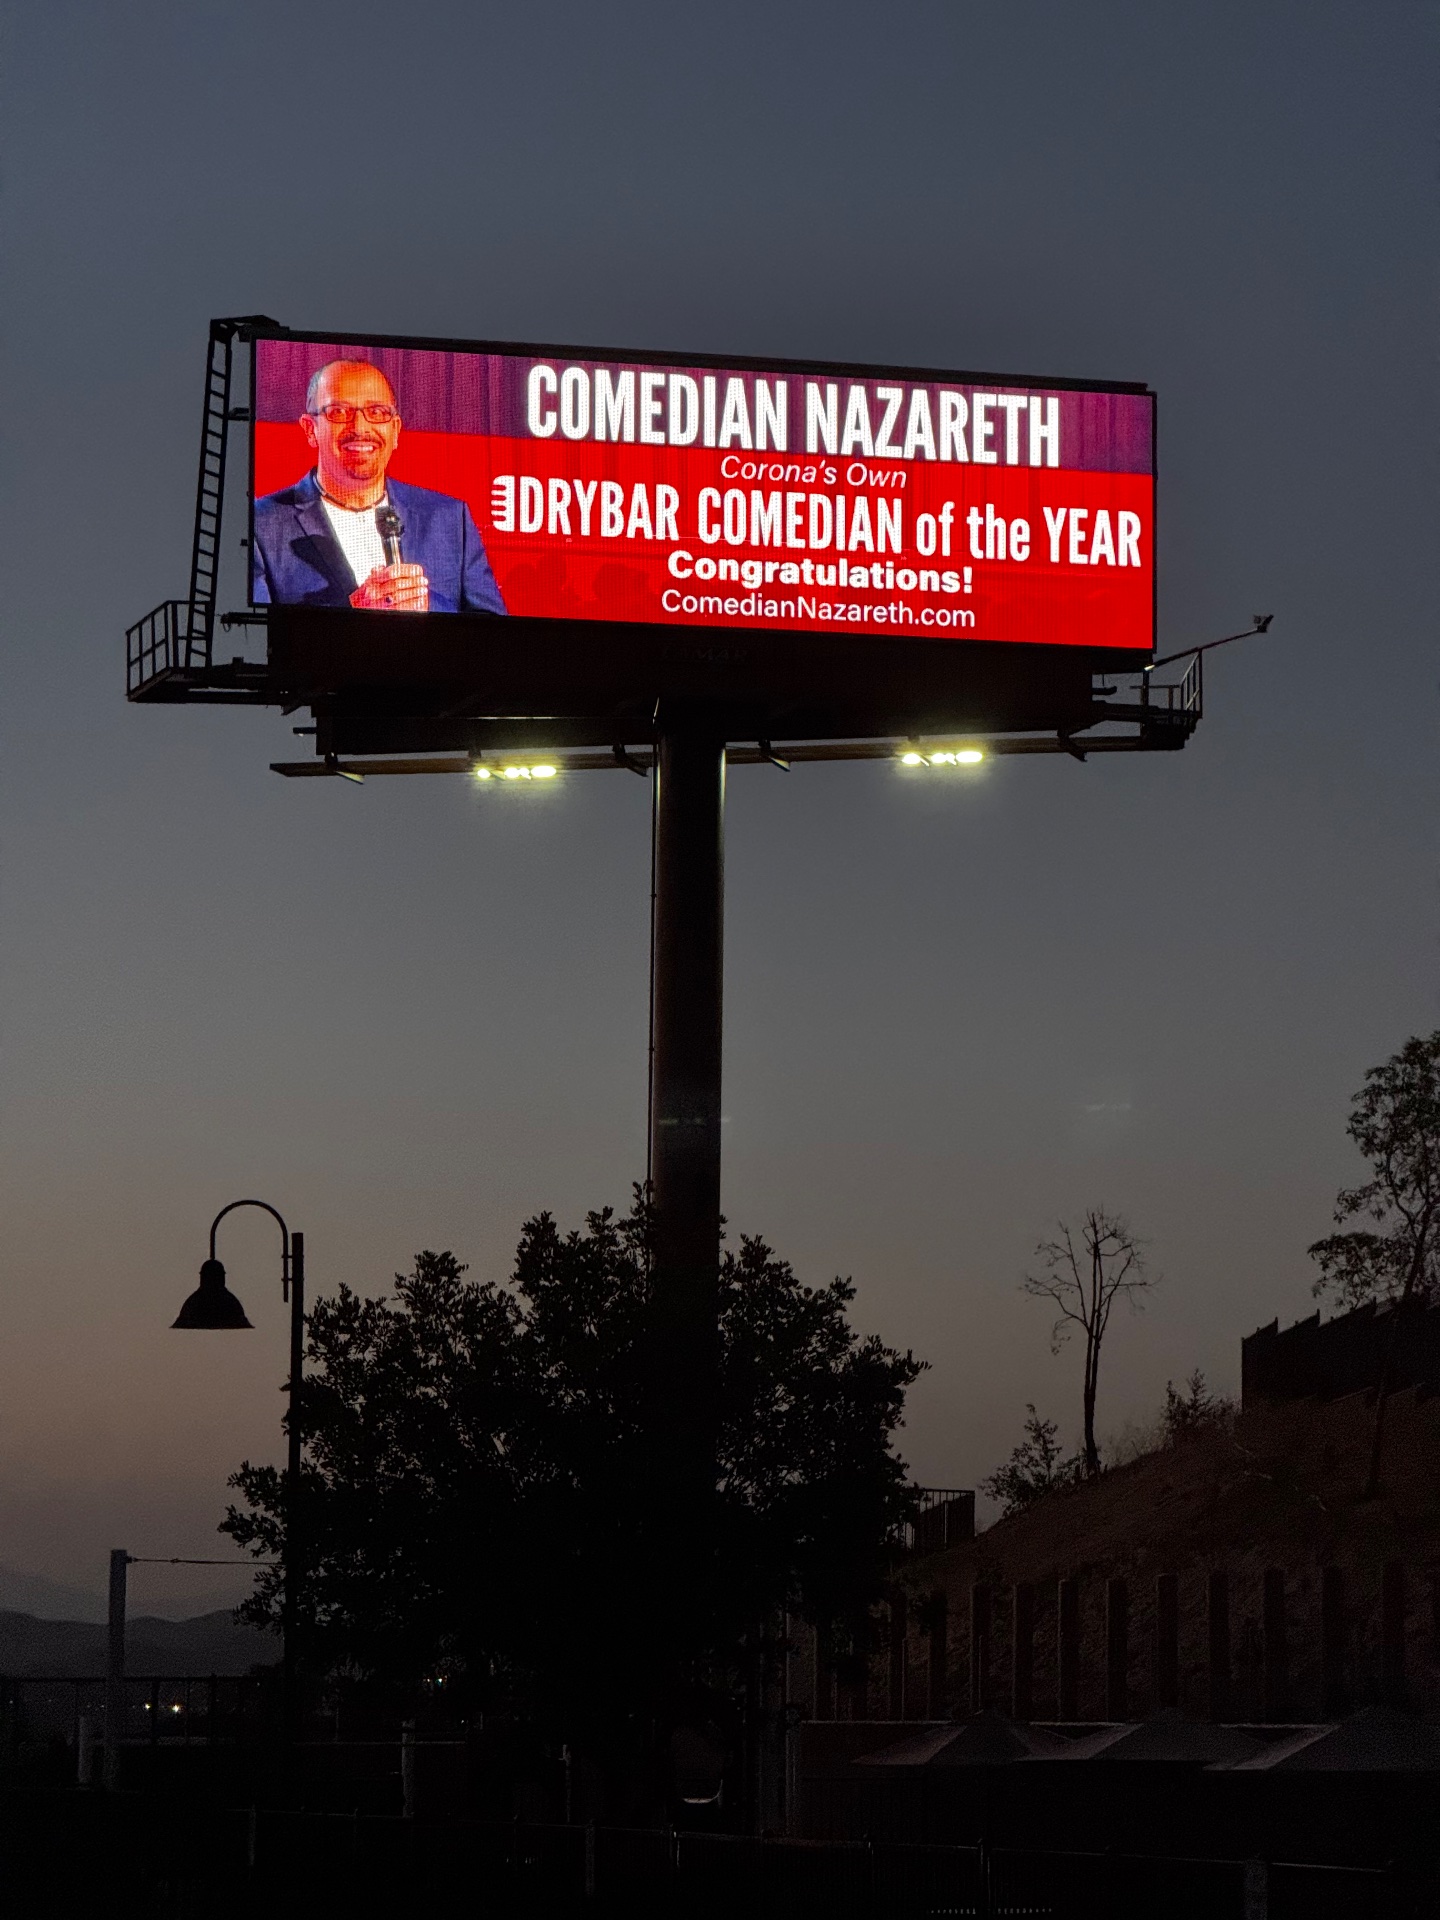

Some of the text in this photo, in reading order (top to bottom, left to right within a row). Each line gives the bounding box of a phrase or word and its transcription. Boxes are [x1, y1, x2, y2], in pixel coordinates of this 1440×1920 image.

[526, 363, 1060, 468] COMEDIAN NAZARETH
[720, 455, 908, 489] Corona's Own
[519, 475, 1142, 568] DRYBAR COMEDIAN of the YEAR
[667, 549, 974, 594] Congratulations!
[661, 589, 976, 628] ComedianNazareth.com
